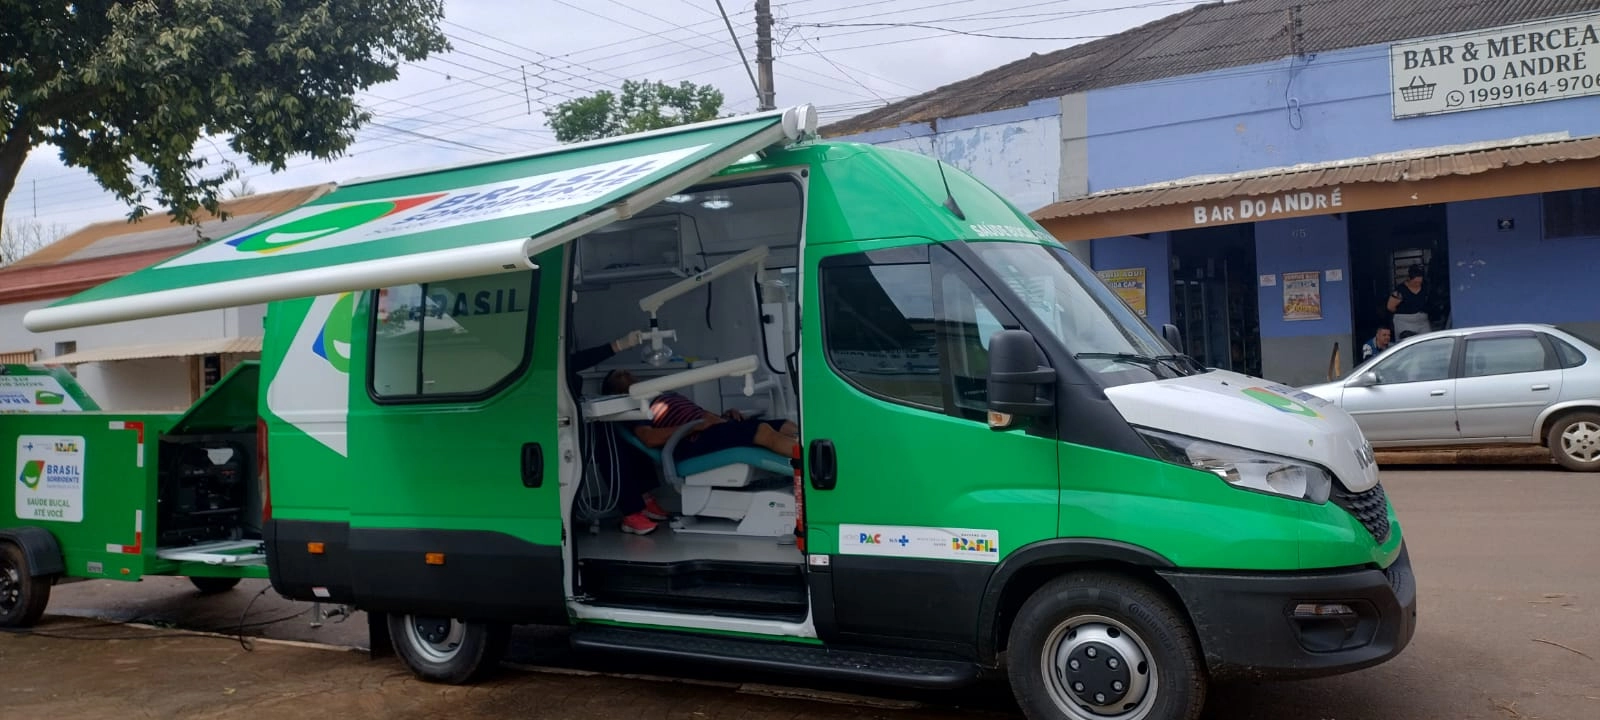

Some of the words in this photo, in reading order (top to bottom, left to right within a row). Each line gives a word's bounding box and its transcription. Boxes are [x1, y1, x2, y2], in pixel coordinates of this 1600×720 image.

[1403, 45, 1455, 70] BAR
[1461, 41, 1479, 62] &
[1487, 24, 1600, 59] MERCEA
[1463, 64, 1496, 85] DO
[1503, 48, 1587, 80] ANDRÉ
[424, 160, 658, 211] BRASIL
[1193, 206, 1235, 224] BAR
[1240, 199, 1266, 218] DO
[1271, 187, 1343, 213] ANDRÉ
[46, 464, 80, 476] BRASIL
[46, 475, 80, 484] SORRIDENTE
[49, 499, 71, 508] BUCAL
[34, 508, 46, 518] ATÉ
[47, 508, 64, 518] VOCÊ
[859, 532, 881, 545] PAC
[952, 536, 998, 553] BRASIL
